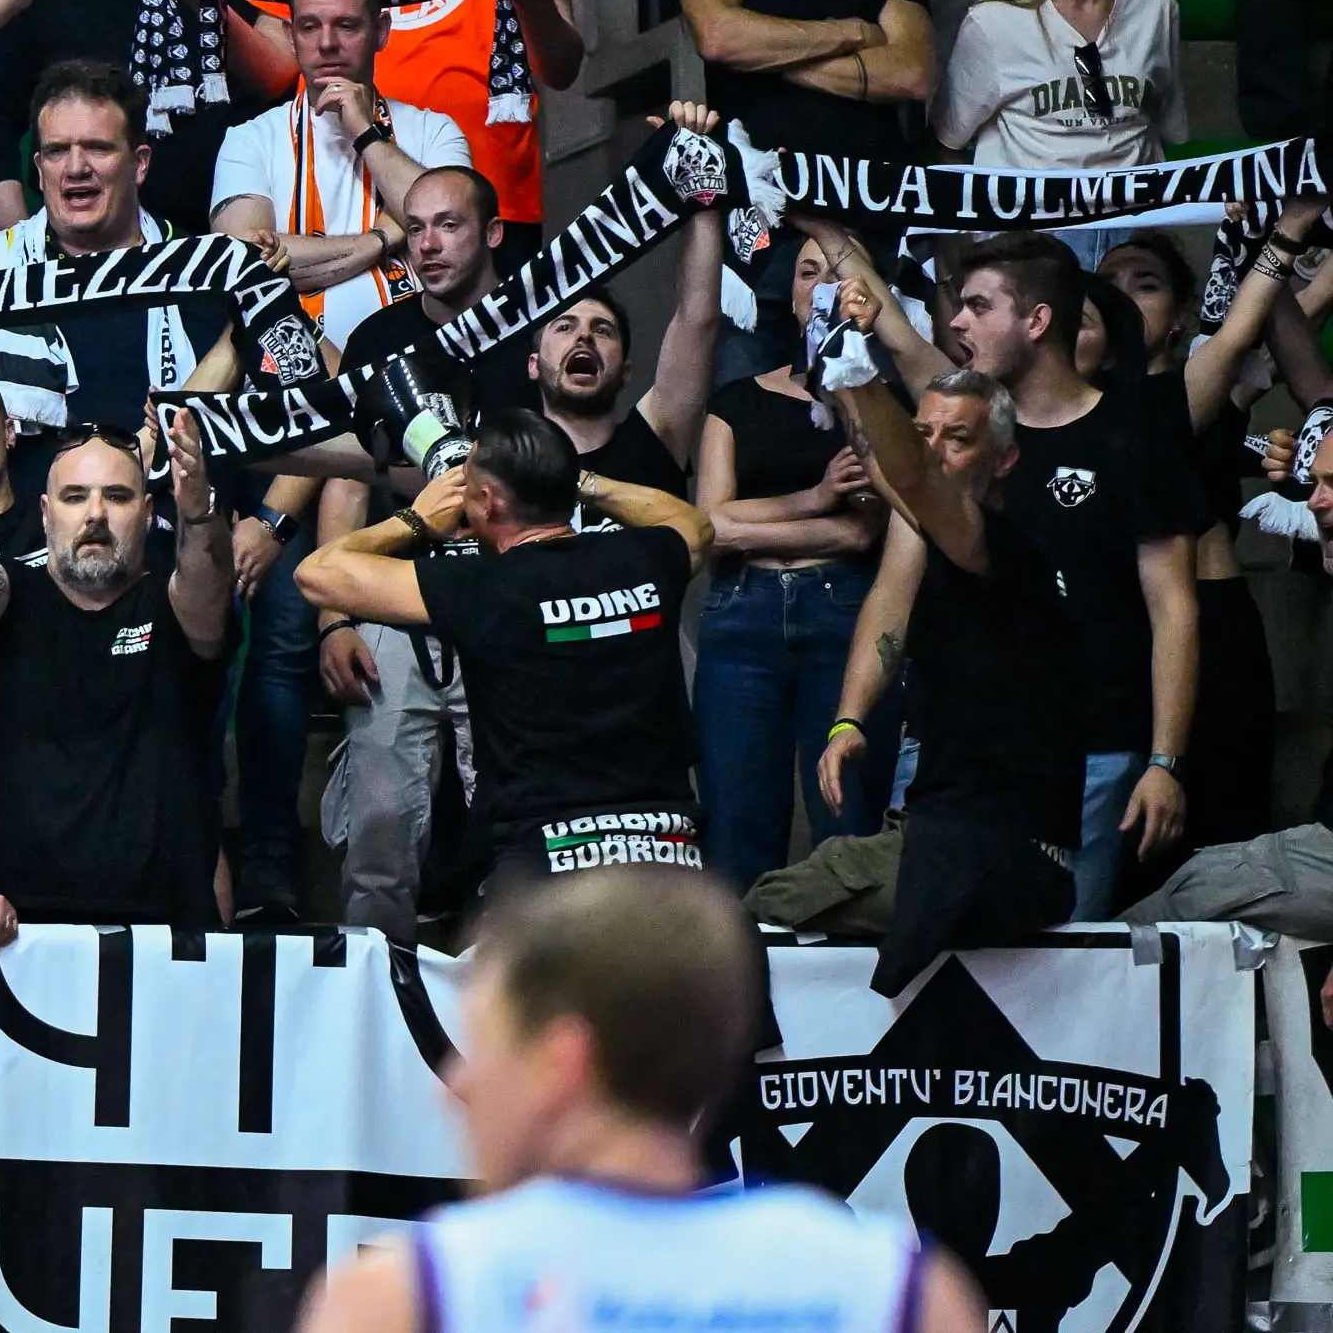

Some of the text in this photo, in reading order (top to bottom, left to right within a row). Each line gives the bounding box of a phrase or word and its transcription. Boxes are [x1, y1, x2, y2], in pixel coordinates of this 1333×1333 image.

[1031, 74, 1157, 117] DIAORA
[773, 152, 934, 215] ONCA
[261, 329, 297, 386] TOLMEZZO
[150, 386, 331, 480] ONCA
[539, 582, 661, 625] UDINE
[549, 839, 704, 874] GUARDIA
[758, 1068, 1169, 1129] GIOVENTU' BIANCONERA
